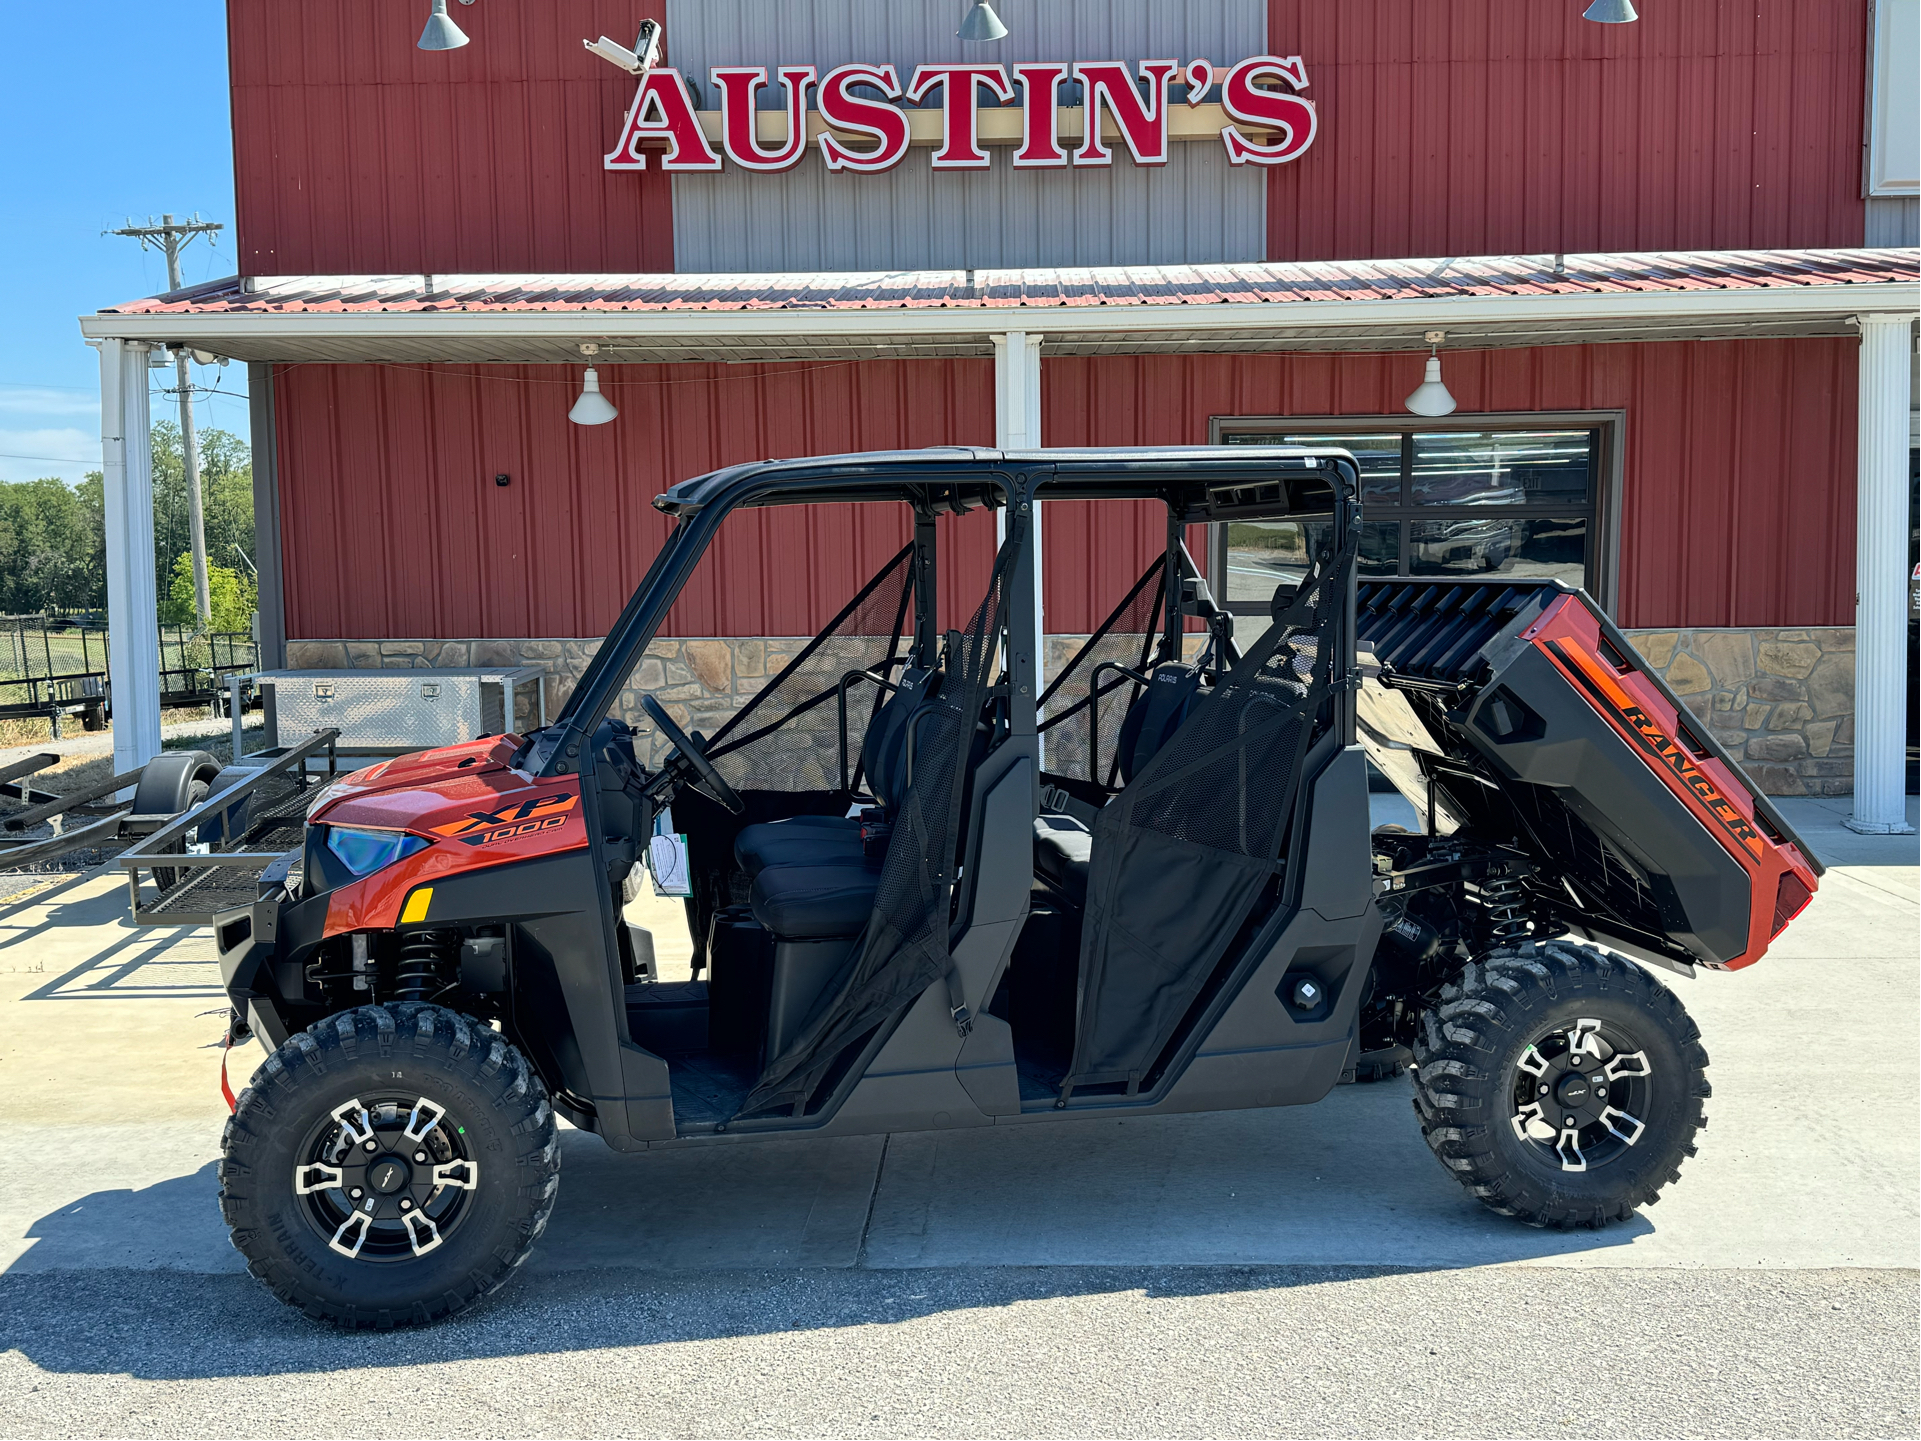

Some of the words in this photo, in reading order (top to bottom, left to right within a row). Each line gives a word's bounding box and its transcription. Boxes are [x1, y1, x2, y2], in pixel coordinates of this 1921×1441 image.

[604, 55, 1318, 173] AUSTIN'S
[1522, 477, 1540, 489] EXIT
[1157, 672, 1178, 684] POLARIS
[1621, 706, 1758, 842] RANGER
[452, 792, 574, 835] XP
[482, 815, 567, 843] 1000
